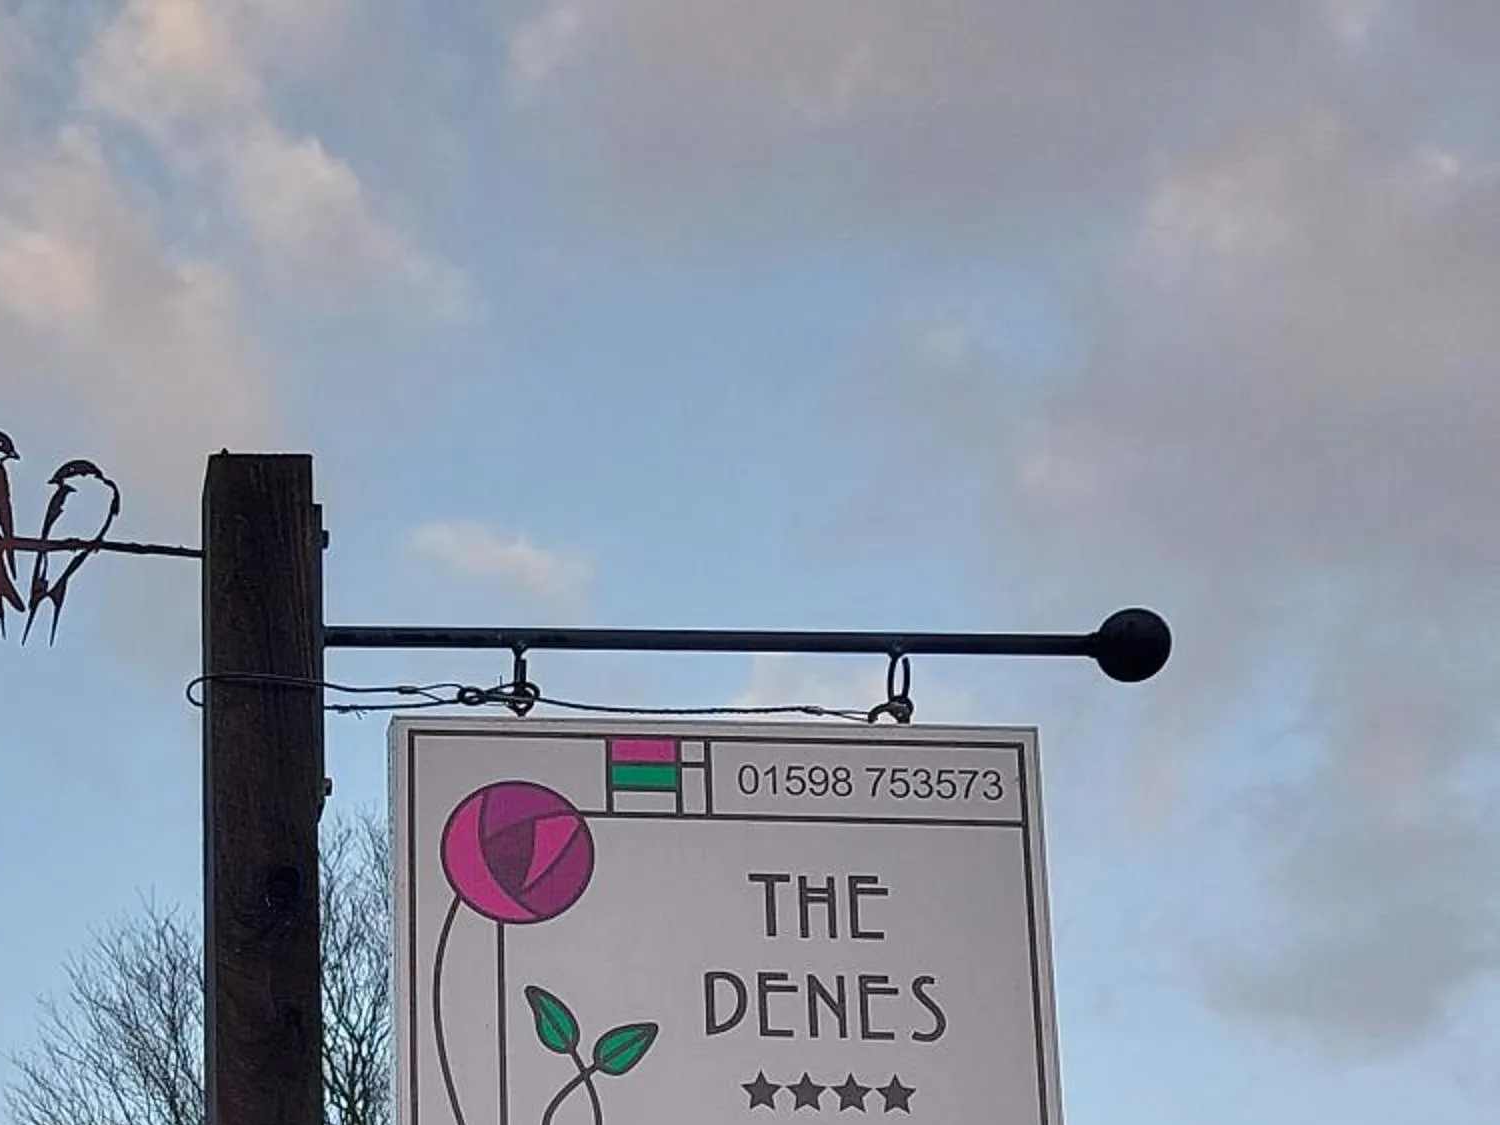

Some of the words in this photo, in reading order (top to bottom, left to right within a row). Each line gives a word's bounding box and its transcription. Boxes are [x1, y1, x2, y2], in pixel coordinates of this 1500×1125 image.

[737, 764, 853, 797] 01598
[865, 767, 1003, 801] 753573
[747, 873, 889, 940] THE
[704, 971, 947, 1043] DENES
